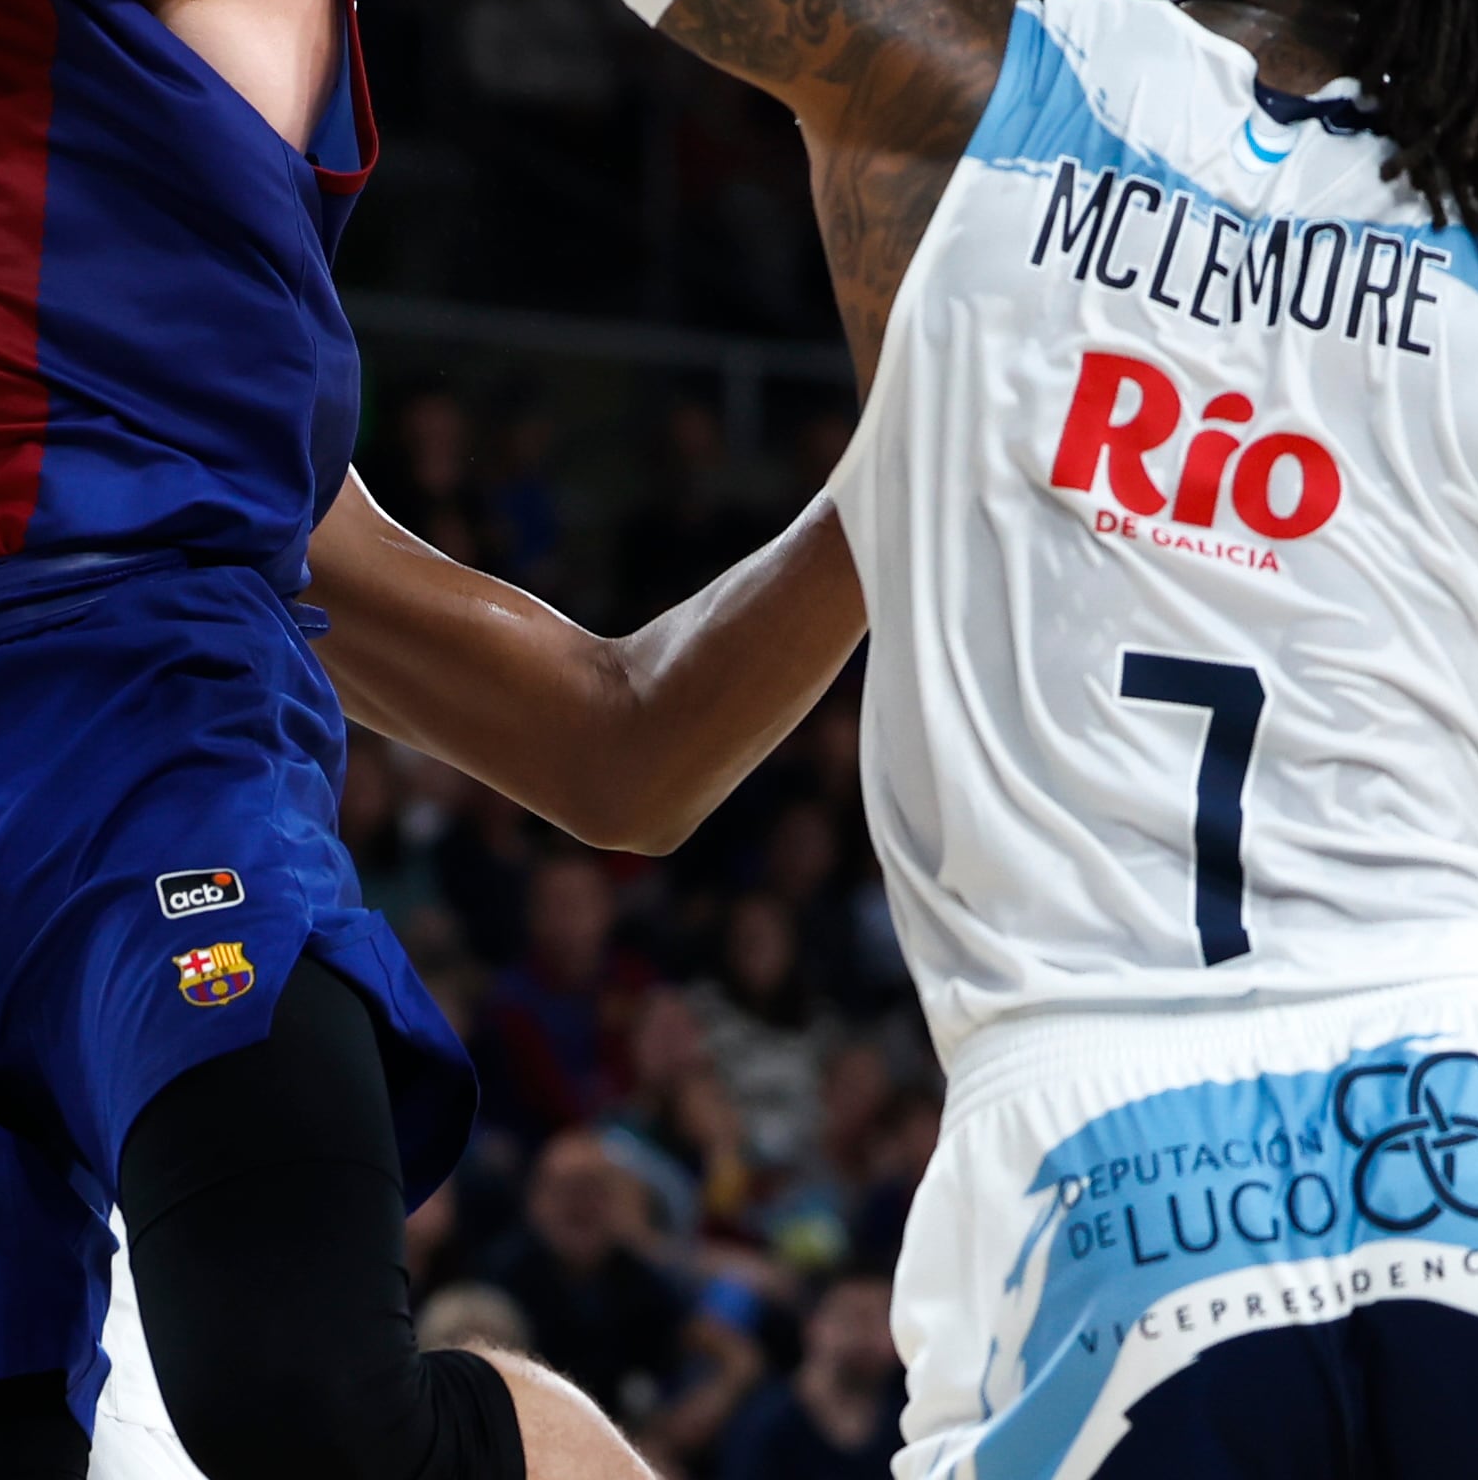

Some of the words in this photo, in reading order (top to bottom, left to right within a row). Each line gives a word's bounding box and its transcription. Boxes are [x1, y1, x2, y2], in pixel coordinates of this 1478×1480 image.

[1030, 160, 1447, 356] MCLEMORE
[1096, 510, 1139, 540] DE
[1151, 527, 1280, 573] GALICIA
[1119, 651, 1267, 968] 7
[169, 883, 225, 910] acb
[1058, 1125, 1323, 1209] DEPUTACIÓN
[1068, 1211, 1117, 1260] DE
[1125, 1173, 1336, 1267] LUGO
